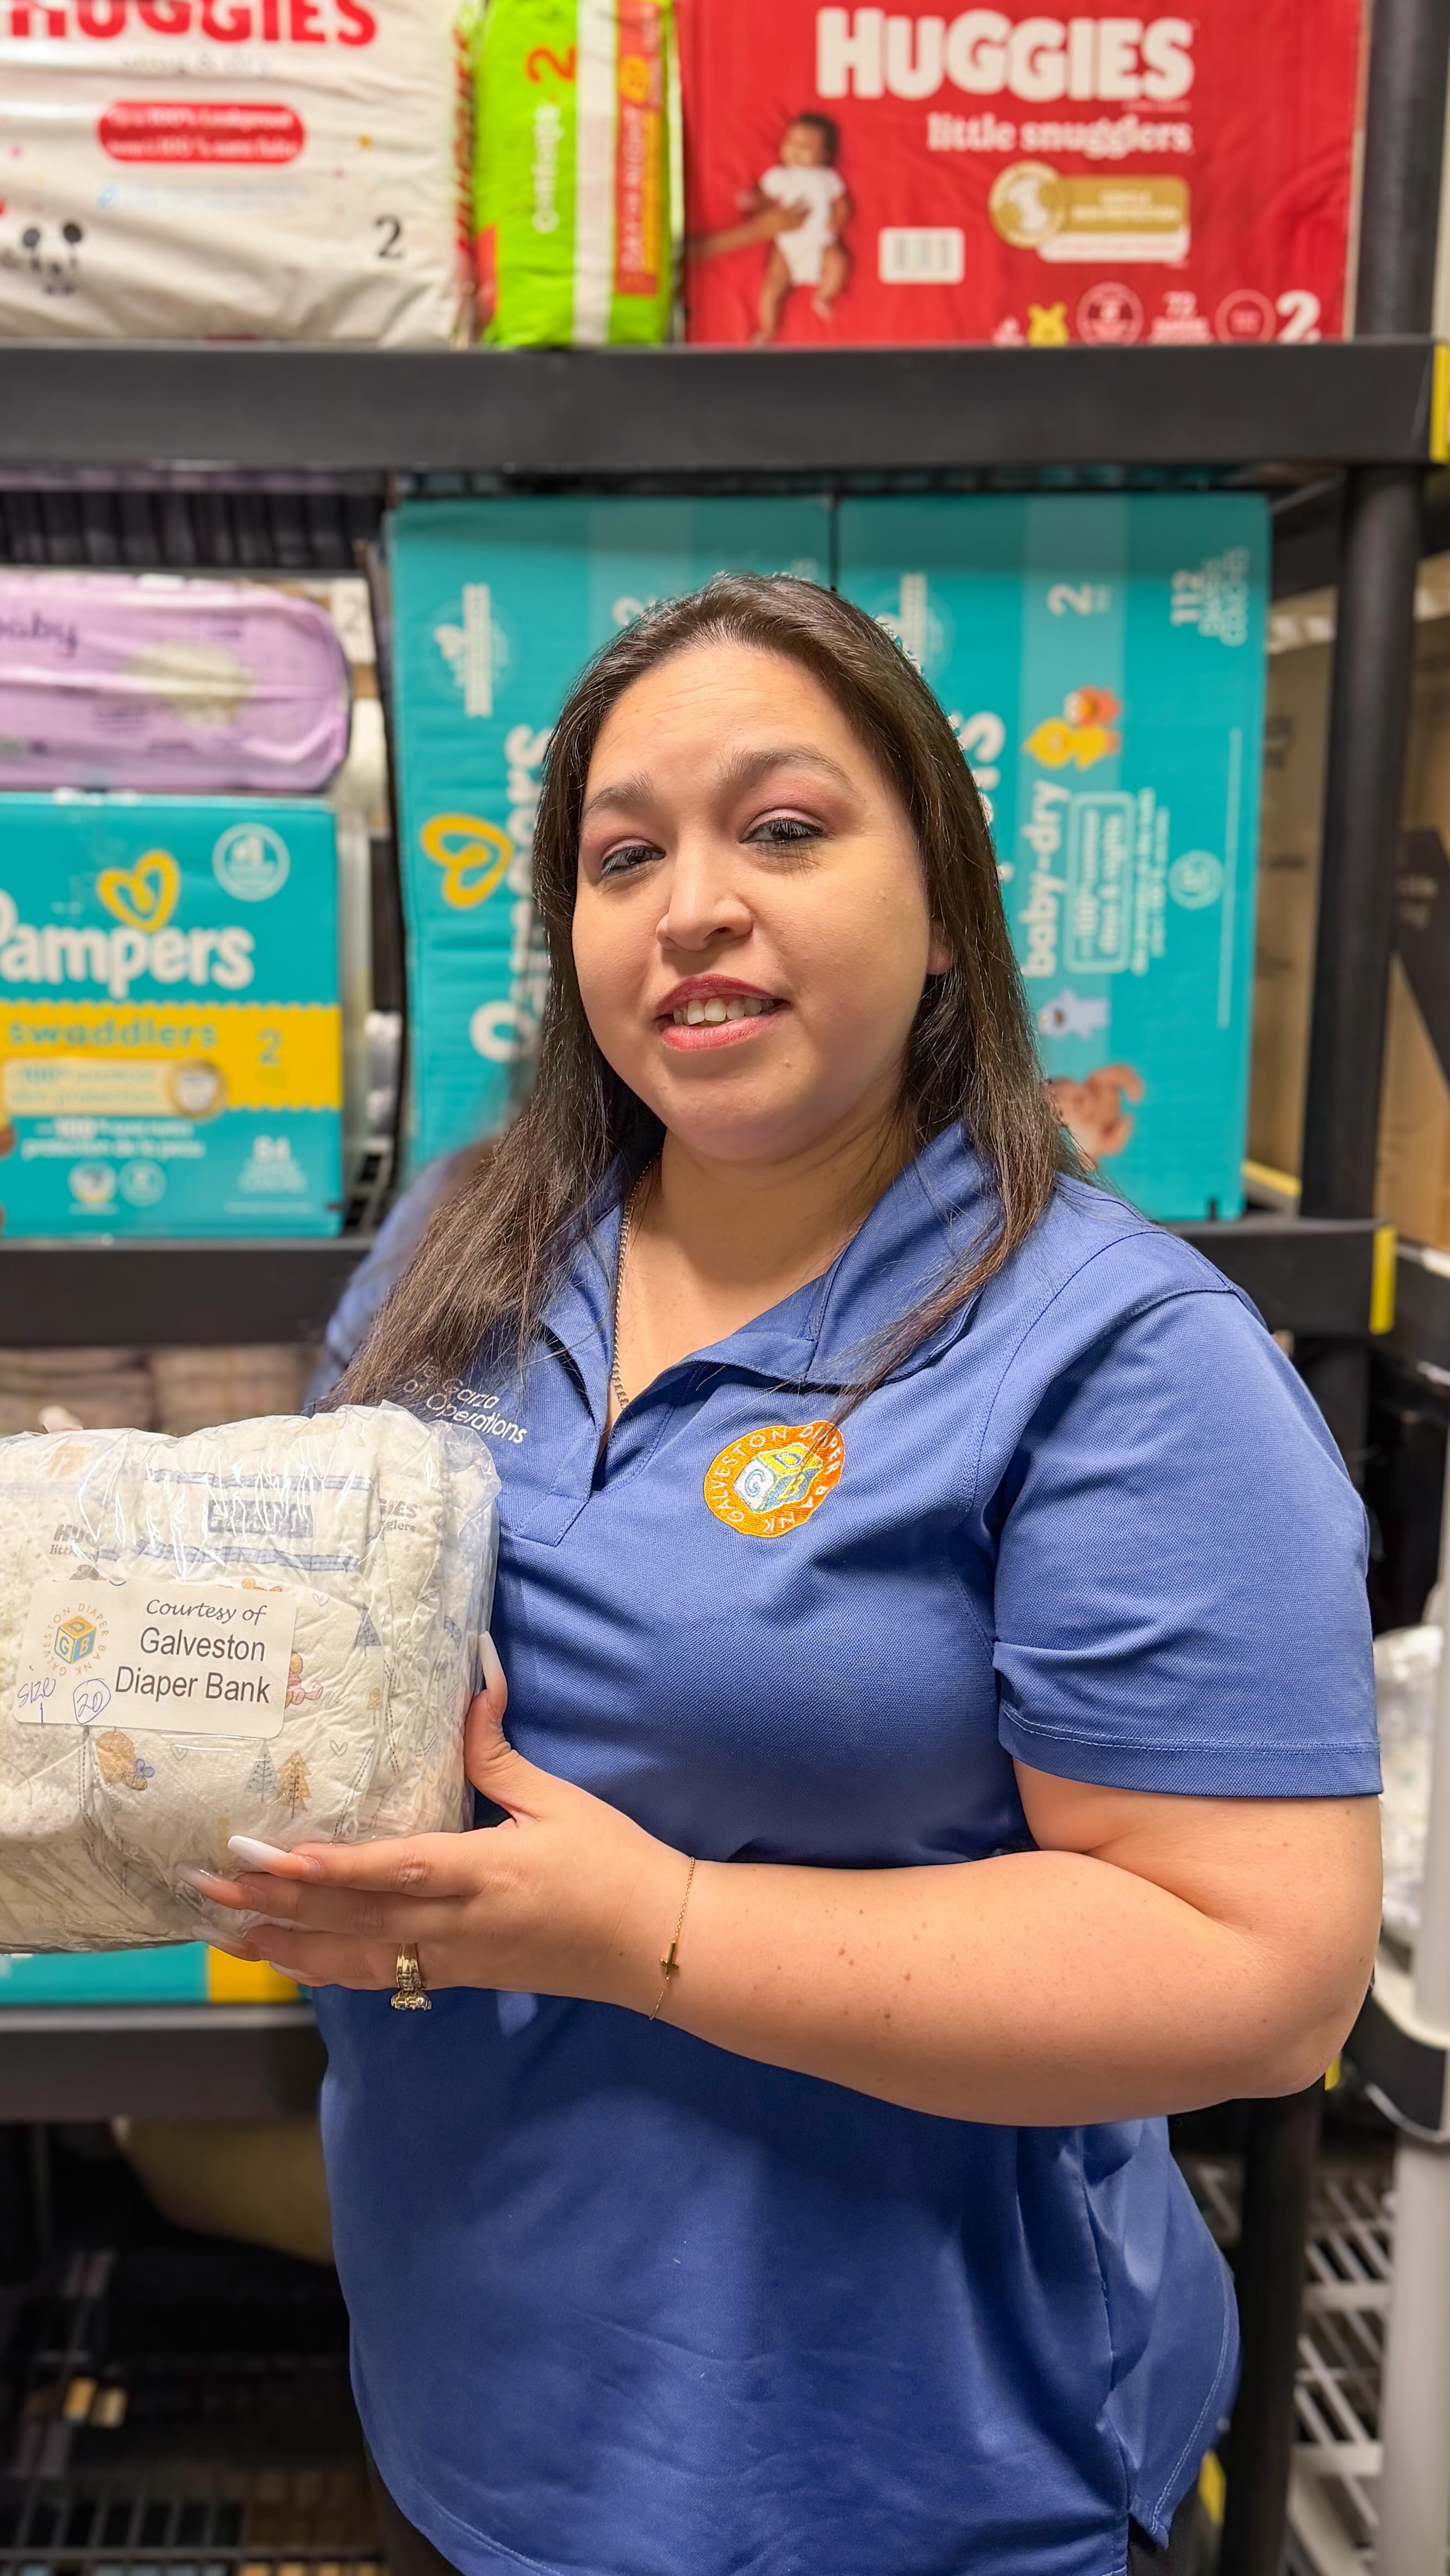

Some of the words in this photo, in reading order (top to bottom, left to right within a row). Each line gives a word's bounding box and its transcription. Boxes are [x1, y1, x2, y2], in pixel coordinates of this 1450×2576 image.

[814, 7, 1194, 102] HUGGIES
[926, 111, 1017, 152] little
[1020, 113, 1193, 160] snugglers
[375, 217, 403, 260] 2
[1276, 289, 1322, 344] 2
[1047, 583, 1092, 617] 2
[1020, 778, 1072, 976] baby-dry
[8, 1018, 219, 1049] swaddlers
[256, 1027, 284, 1067] 2
[426, 1392, 528, 1443] Operations
[709, 1428, 787, 1523] GALVESTON
[763, 1485, 829, 1533] BANK
[78, 1603, 109, 1636] DIAPER
[146, 1599, 237, 1624] Courtesy
[242, 1605, 267, 1625] of
[43, 1606, 70, 1676] GALVESTON
[76, 1645, 107, 1675] BANK
[140, 1627, 265, 1661] Galveston
[76, 1691, 103, 1717] 20
[115, 1666, 198, 1702] Diaper
[205, 1672, 271, 1704] Bank
